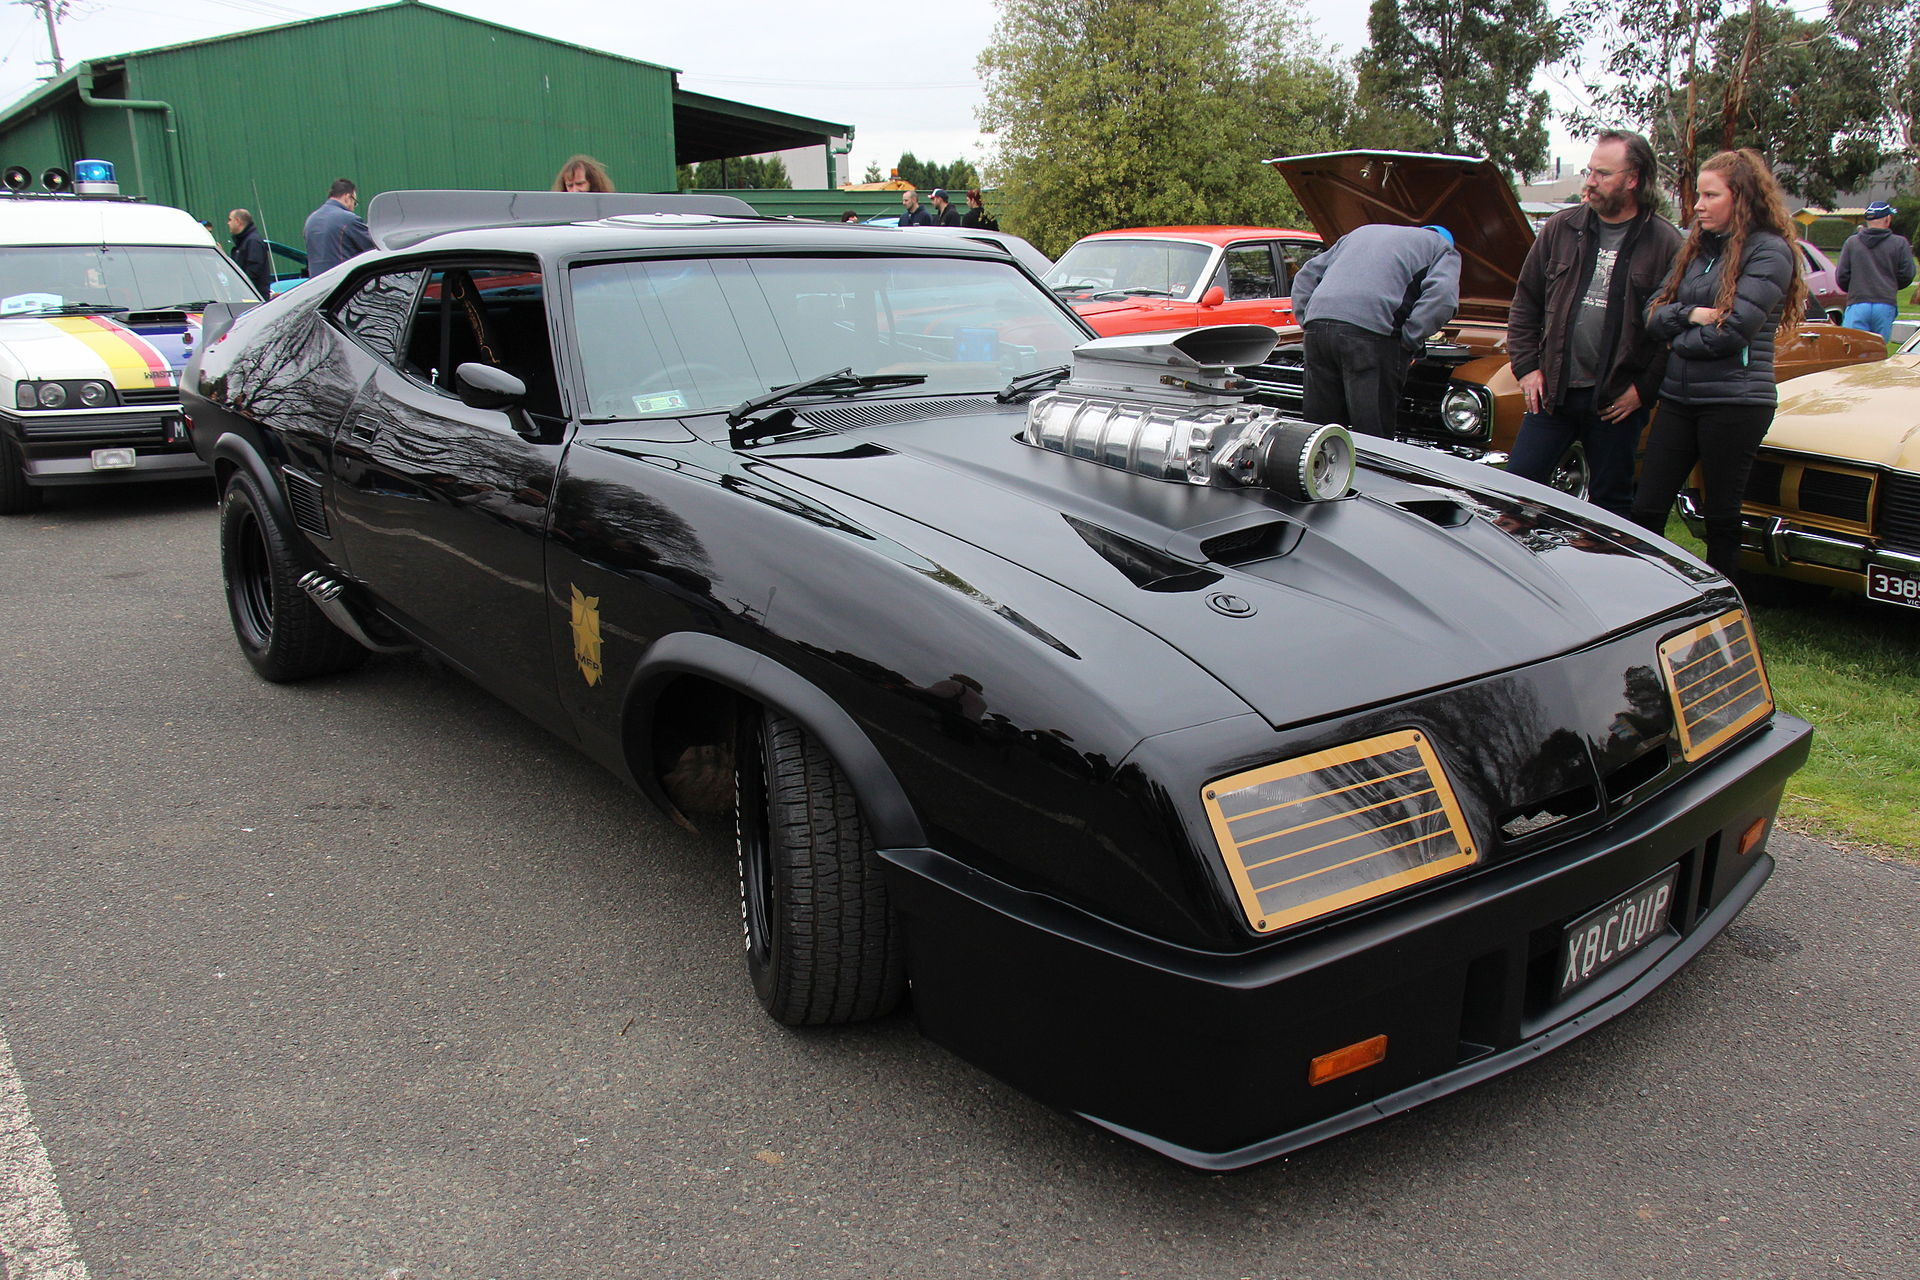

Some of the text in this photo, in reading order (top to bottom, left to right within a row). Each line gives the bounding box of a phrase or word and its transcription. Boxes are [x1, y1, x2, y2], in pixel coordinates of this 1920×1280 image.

[1874, 574, 1920, 599] 338
[577, 652, 600, 671] MFP
[1614, 897, 1632, 912] VIC
[1561, 884, 1670, 989] XBCOUP
